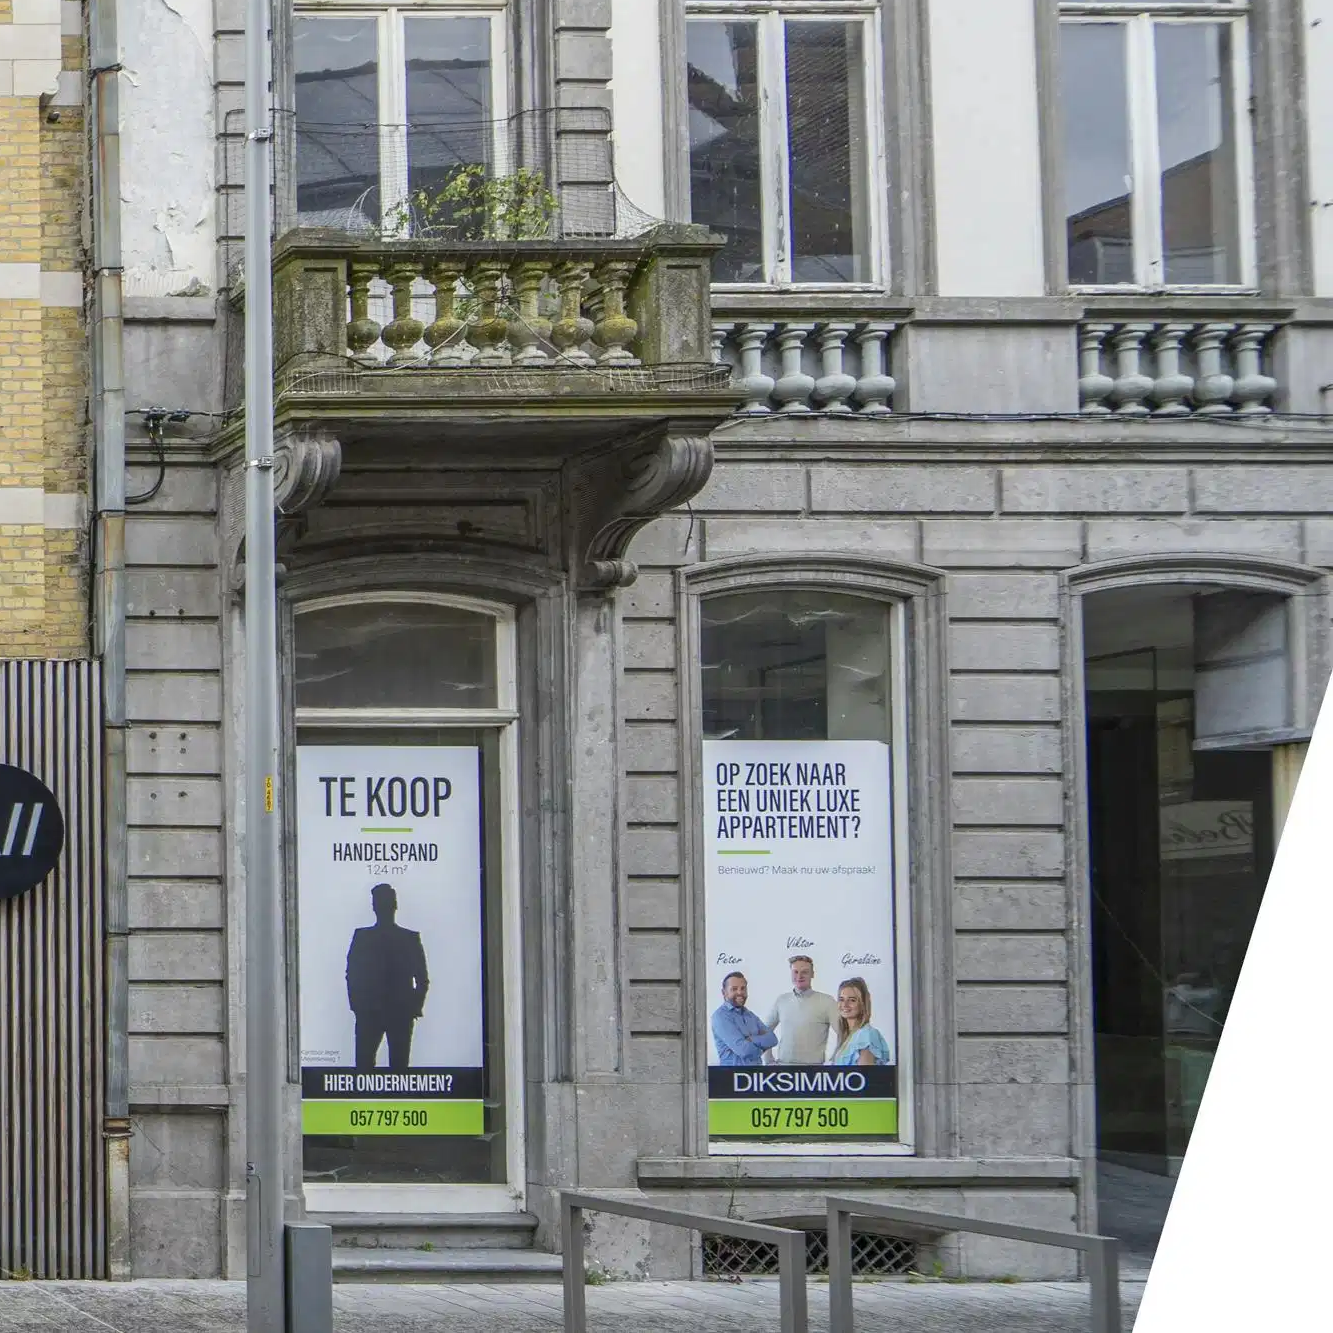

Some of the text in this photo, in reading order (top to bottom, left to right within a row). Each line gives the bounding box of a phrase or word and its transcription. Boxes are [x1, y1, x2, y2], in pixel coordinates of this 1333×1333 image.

[716, 762, 846, 786] OP ZOEK NAAR
[319, 776, 452, 817] TE KOOP
[717, 789, 860, 812] EEN UNIEK LUXE
[717, 815, 861, 839] APPARTEMENT?
[333, 842, 438, 862] HANDELSPAND
[367, 865, 389, 875] 124
[718, 865, 769, 875] Benieuwd?
[771, 866, 798, 875] Maak
[832, 865, 876, 877] afspraak!
[786, 936, 815, 949] Viktor
[716, 952, 744, 965] Peter
[324, 1074, 453, 1092] HIER ONDERNEMEN?
[733, 1071, 866, 1092] DIKSIMMO
[350, 1110, 428, 1126] 057 797 500
[751, 1107, 849, 1127] 057 797 500
